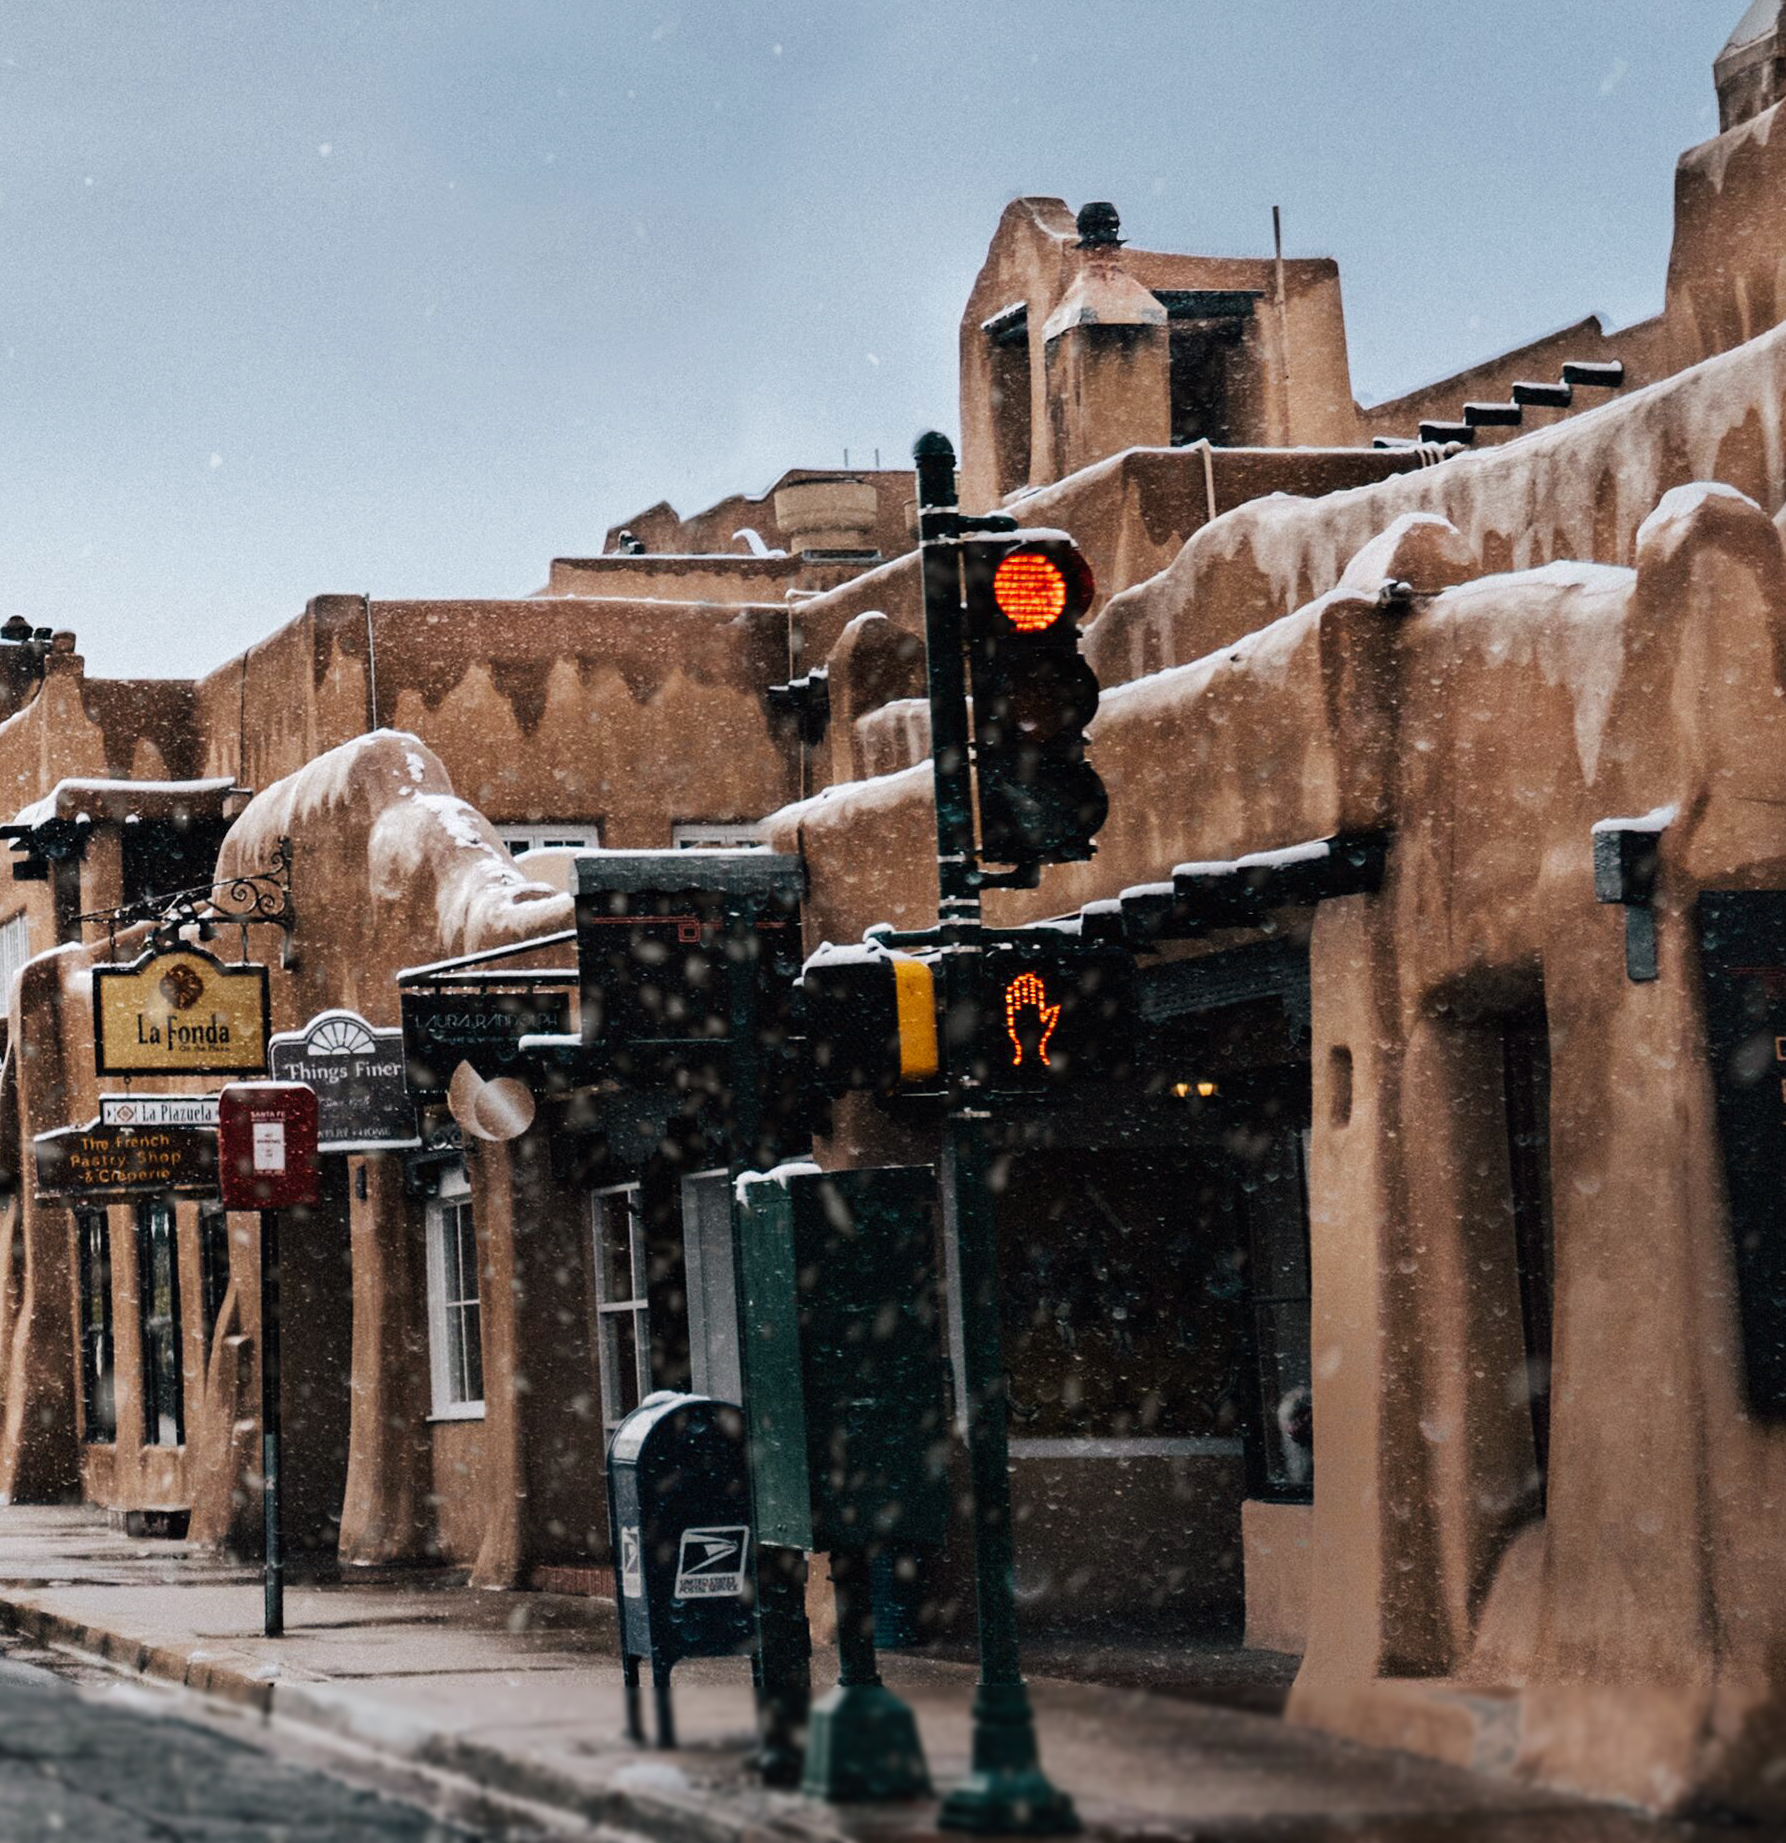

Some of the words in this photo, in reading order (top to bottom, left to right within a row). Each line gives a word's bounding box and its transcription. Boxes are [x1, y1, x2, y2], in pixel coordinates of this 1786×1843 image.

[137, 1013, 160, 1045] La
[167, 1013, 230, 1051] Fonda
[283, 1061, 348, 1084] Things
[355, 1061, 402, 1077] Finer
[142, 1104, 156, 1122] La
[161, 1103, 212, 1122] Plazuela
[80, 1136, 110, 1151] The
[70, 1153, 126, 1169] Pastry
[136, 1149, 182, 1166] Shop
[84, 1171, 94, 1184] &
